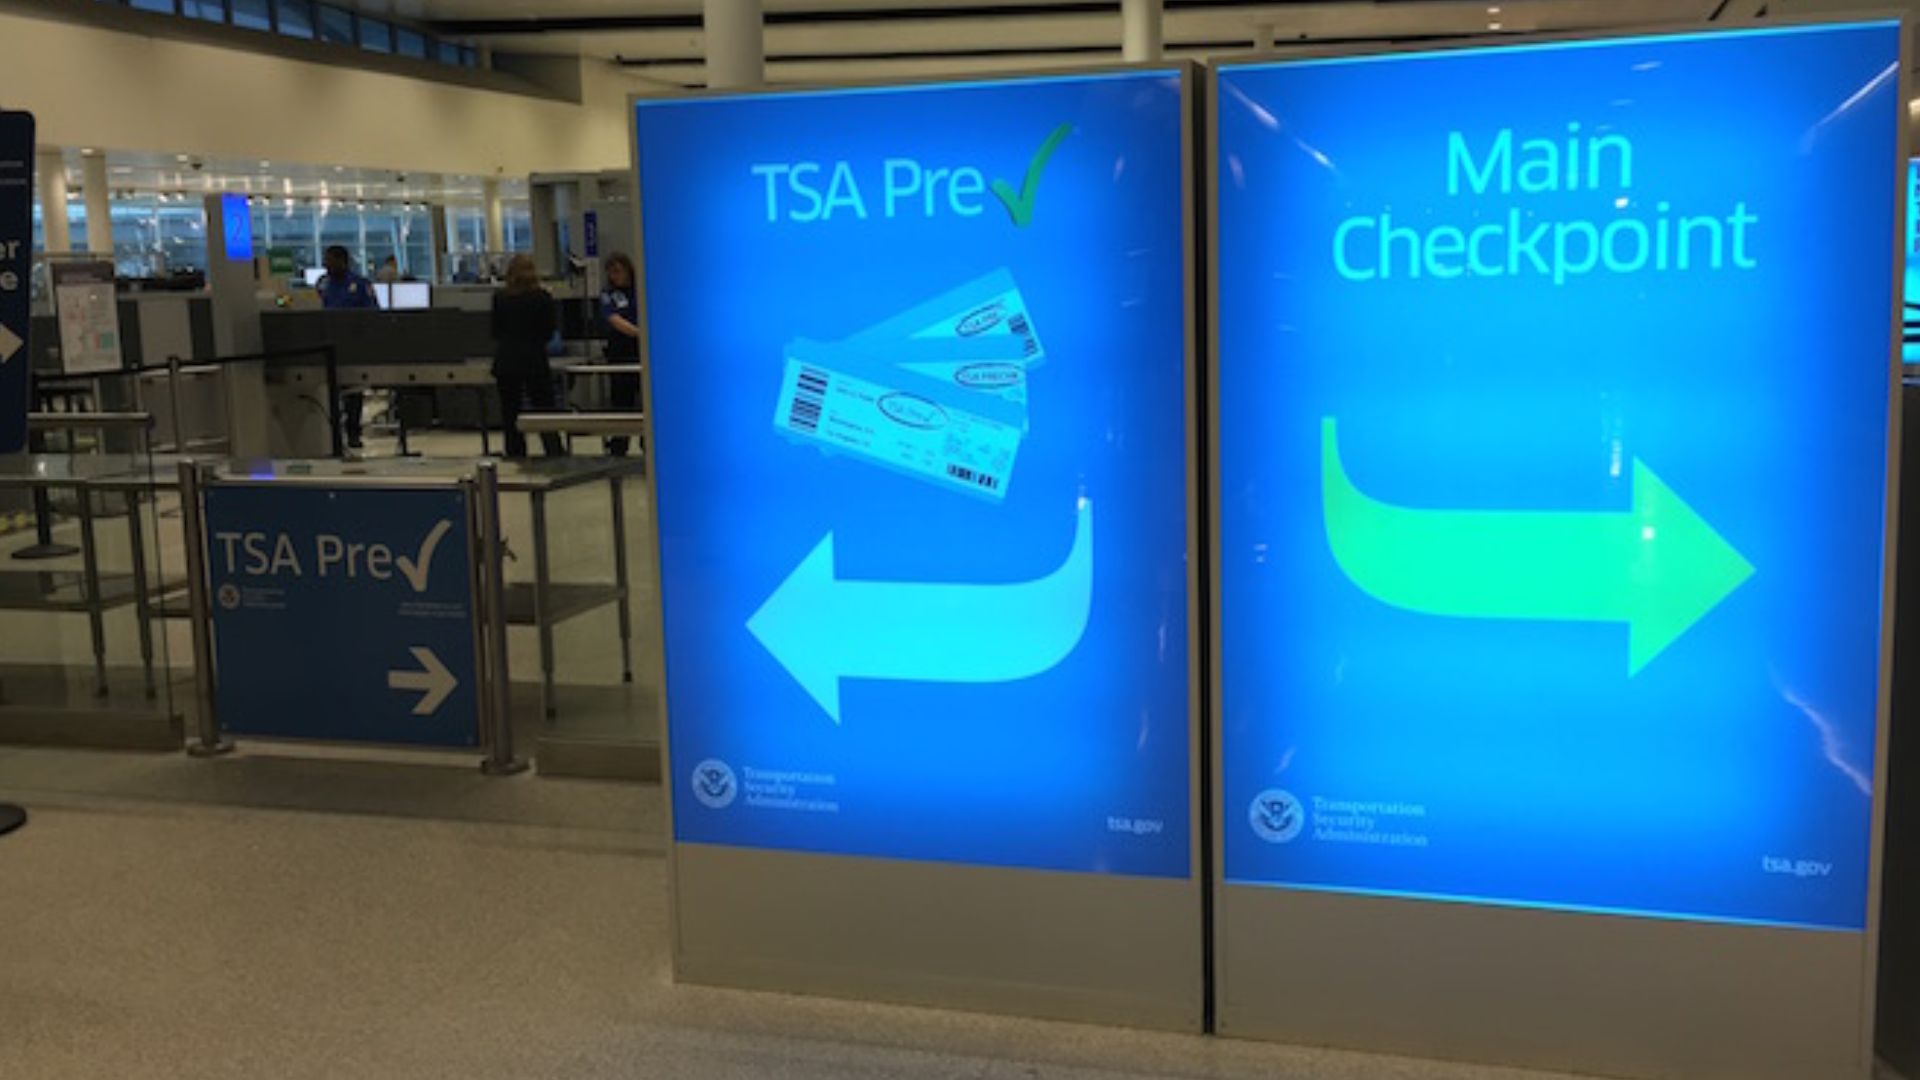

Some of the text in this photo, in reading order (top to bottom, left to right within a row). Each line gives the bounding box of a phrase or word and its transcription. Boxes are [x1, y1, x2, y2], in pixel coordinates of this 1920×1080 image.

[1447, 121, 1633, 196] Main
[751, 158, 985, 223] TSA Pre
[1332, 201, 1759, 285] Checkpoint
[216, 532, 393, 580] TSA Pre
[1310, 795, 1425, 816] Transportation
[1312, 812, 1375, 831] Security
[1312, 827, 1429, 847] Administration
[1762, 855, 1833, 876] tsa.gov
